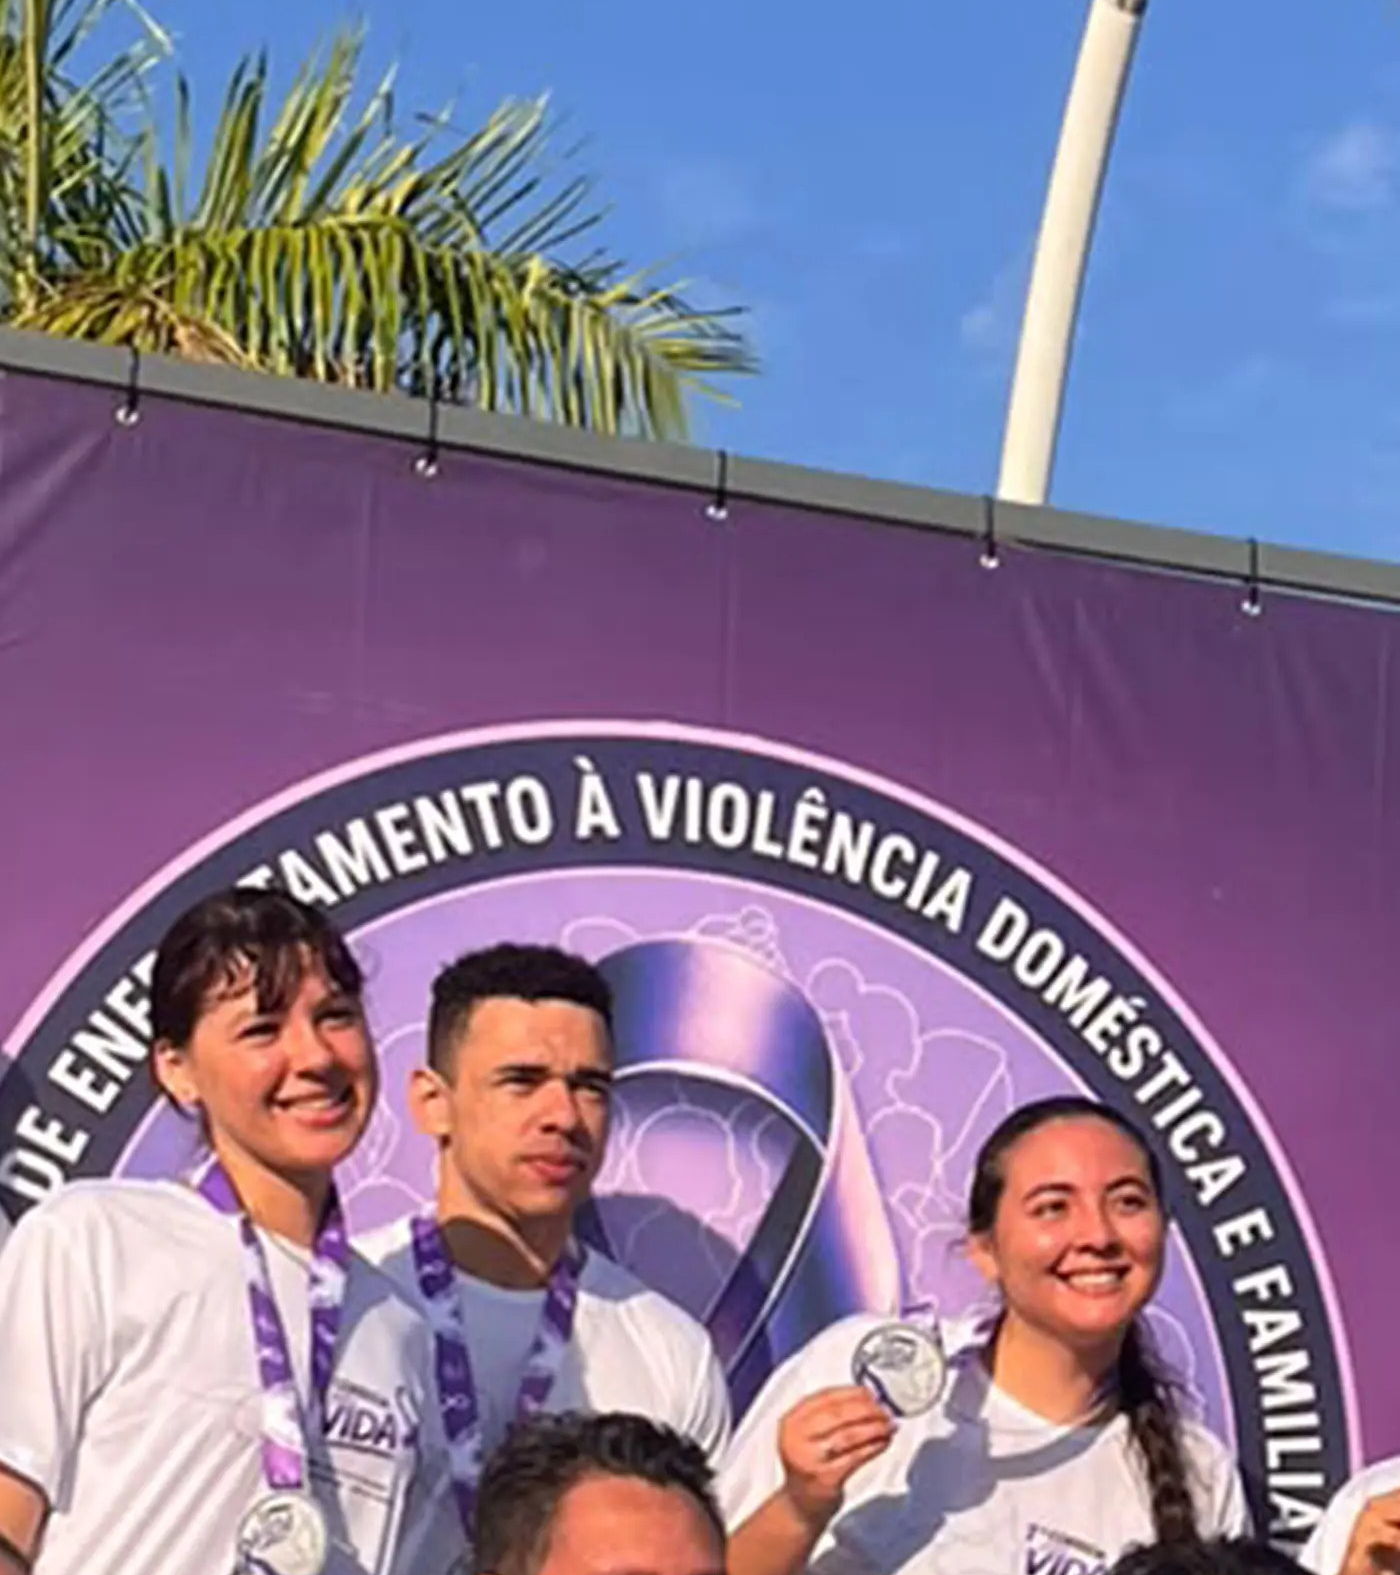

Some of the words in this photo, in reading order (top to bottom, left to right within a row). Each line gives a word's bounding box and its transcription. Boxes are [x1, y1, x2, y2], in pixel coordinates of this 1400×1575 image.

[574, 757, 621, 839] À
[637, 772, 980, 932] VIOLÊNCIA
[977, 899, 1247, 1206] DOMÉSTICA
[1213, 1208, 1274, 1256] E
[1234, 1264, 1325, 1557] FAMILIA
